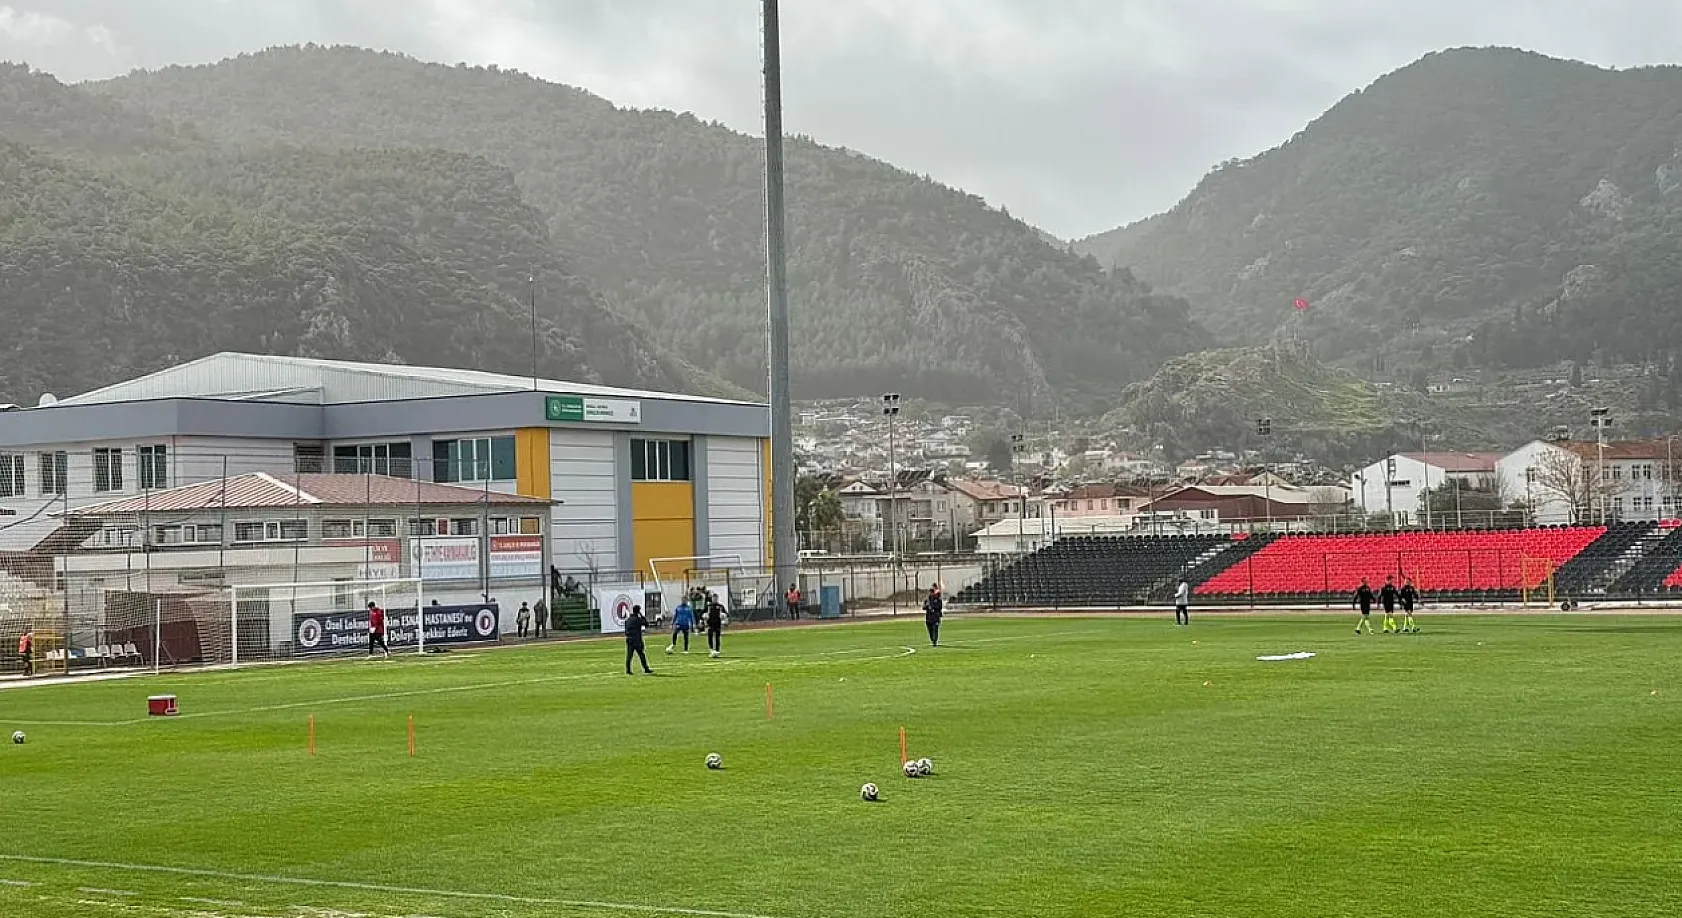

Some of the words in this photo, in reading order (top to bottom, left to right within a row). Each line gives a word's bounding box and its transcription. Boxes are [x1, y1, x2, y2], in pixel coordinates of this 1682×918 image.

[325, 617, 343, 631] Özel
[344, 617, 369, 630] Lokma
[401, 614, 420, 626] ESNA
[447, 625, 468, 638] Ederiz
